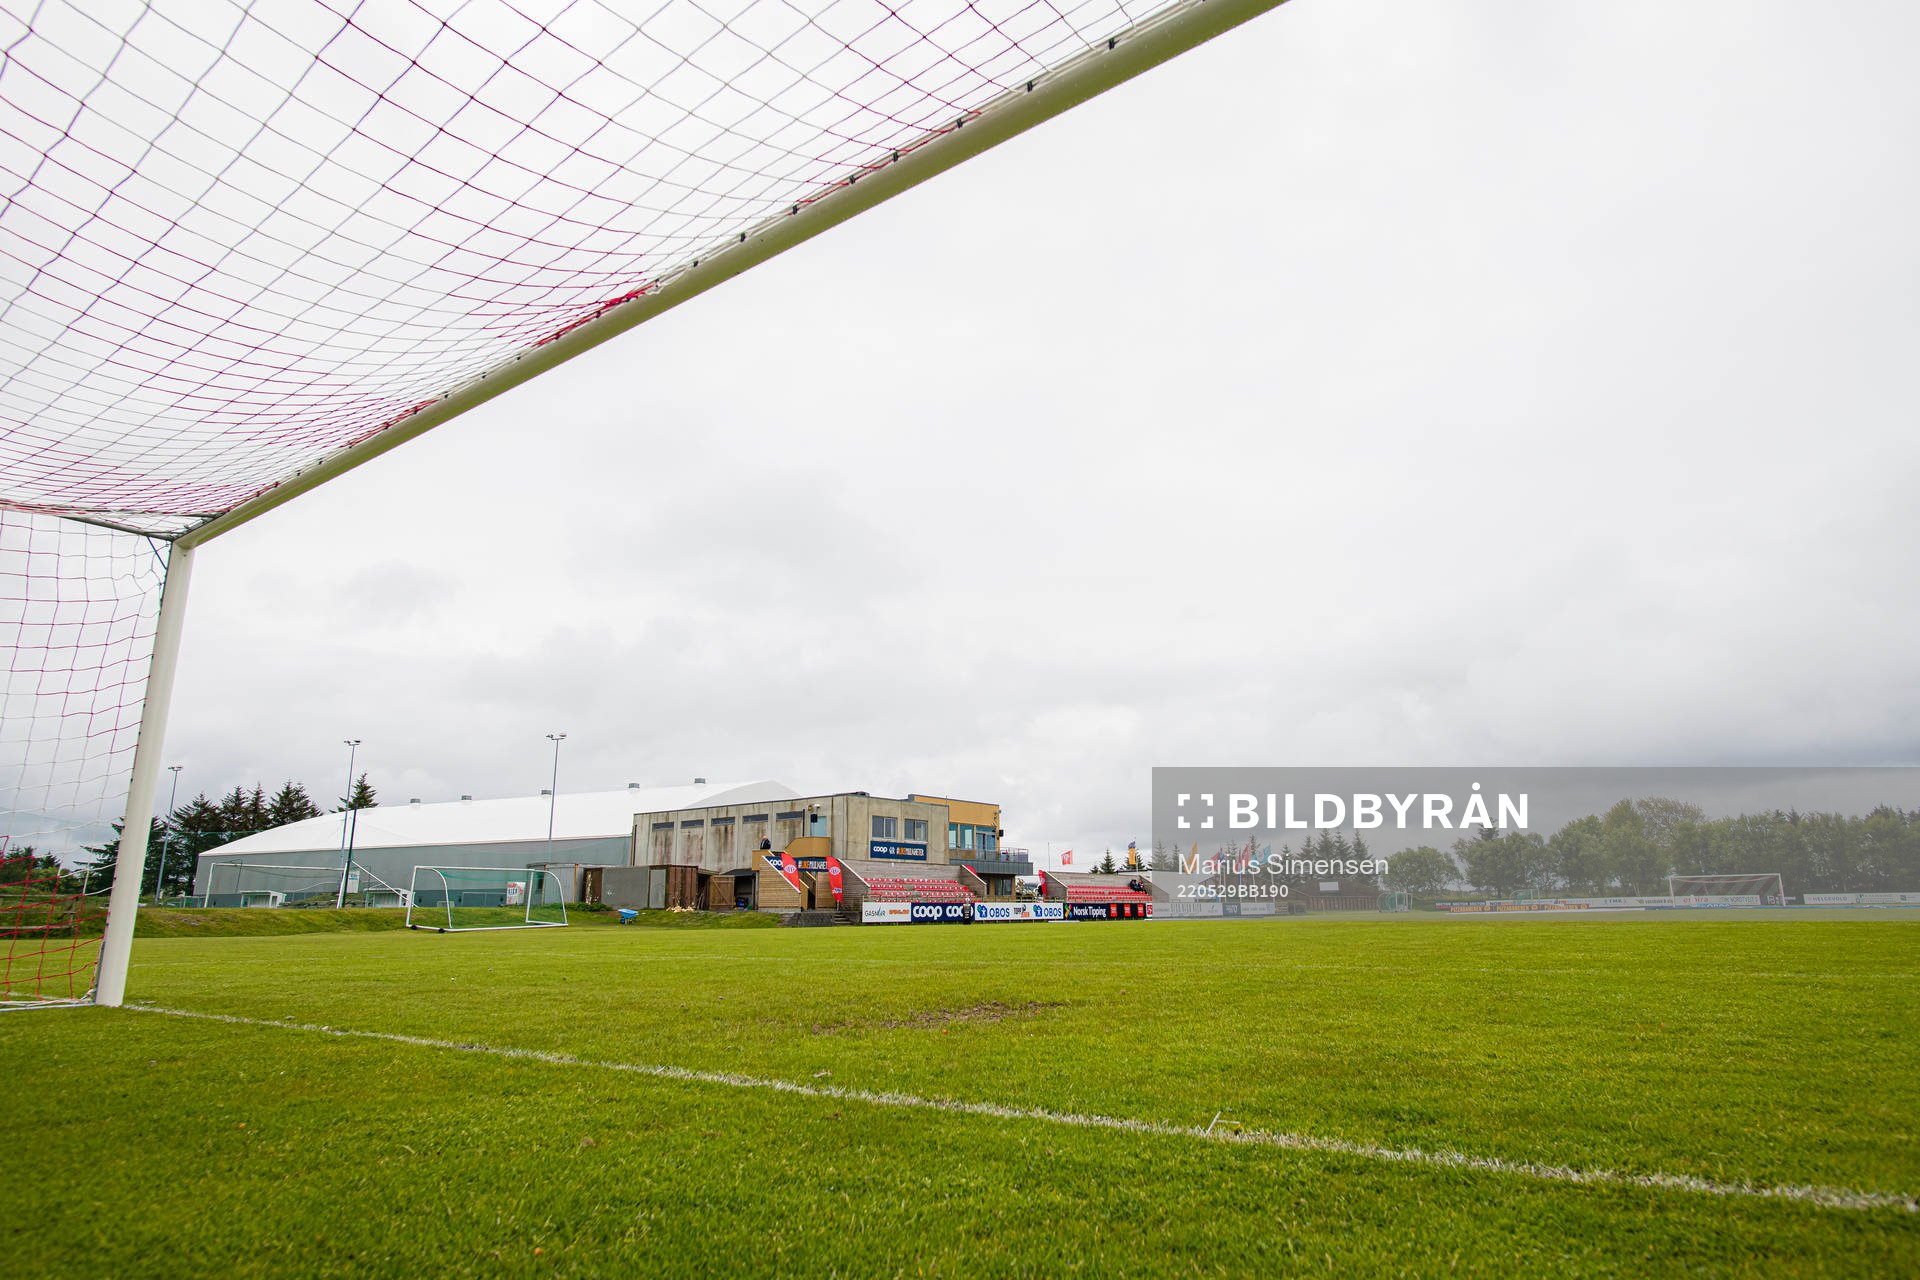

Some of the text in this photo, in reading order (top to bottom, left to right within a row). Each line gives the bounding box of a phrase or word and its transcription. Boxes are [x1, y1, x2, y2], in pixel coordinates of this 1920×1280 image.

[912, 905, 943, 920] coop
[989, 907, 1010, 918] OBOS
[1043, 907, 1062, 917] OBOS
[1073, 906, 1088, 916] Norsk
[1088, 906, 1107, 918] Tipping
